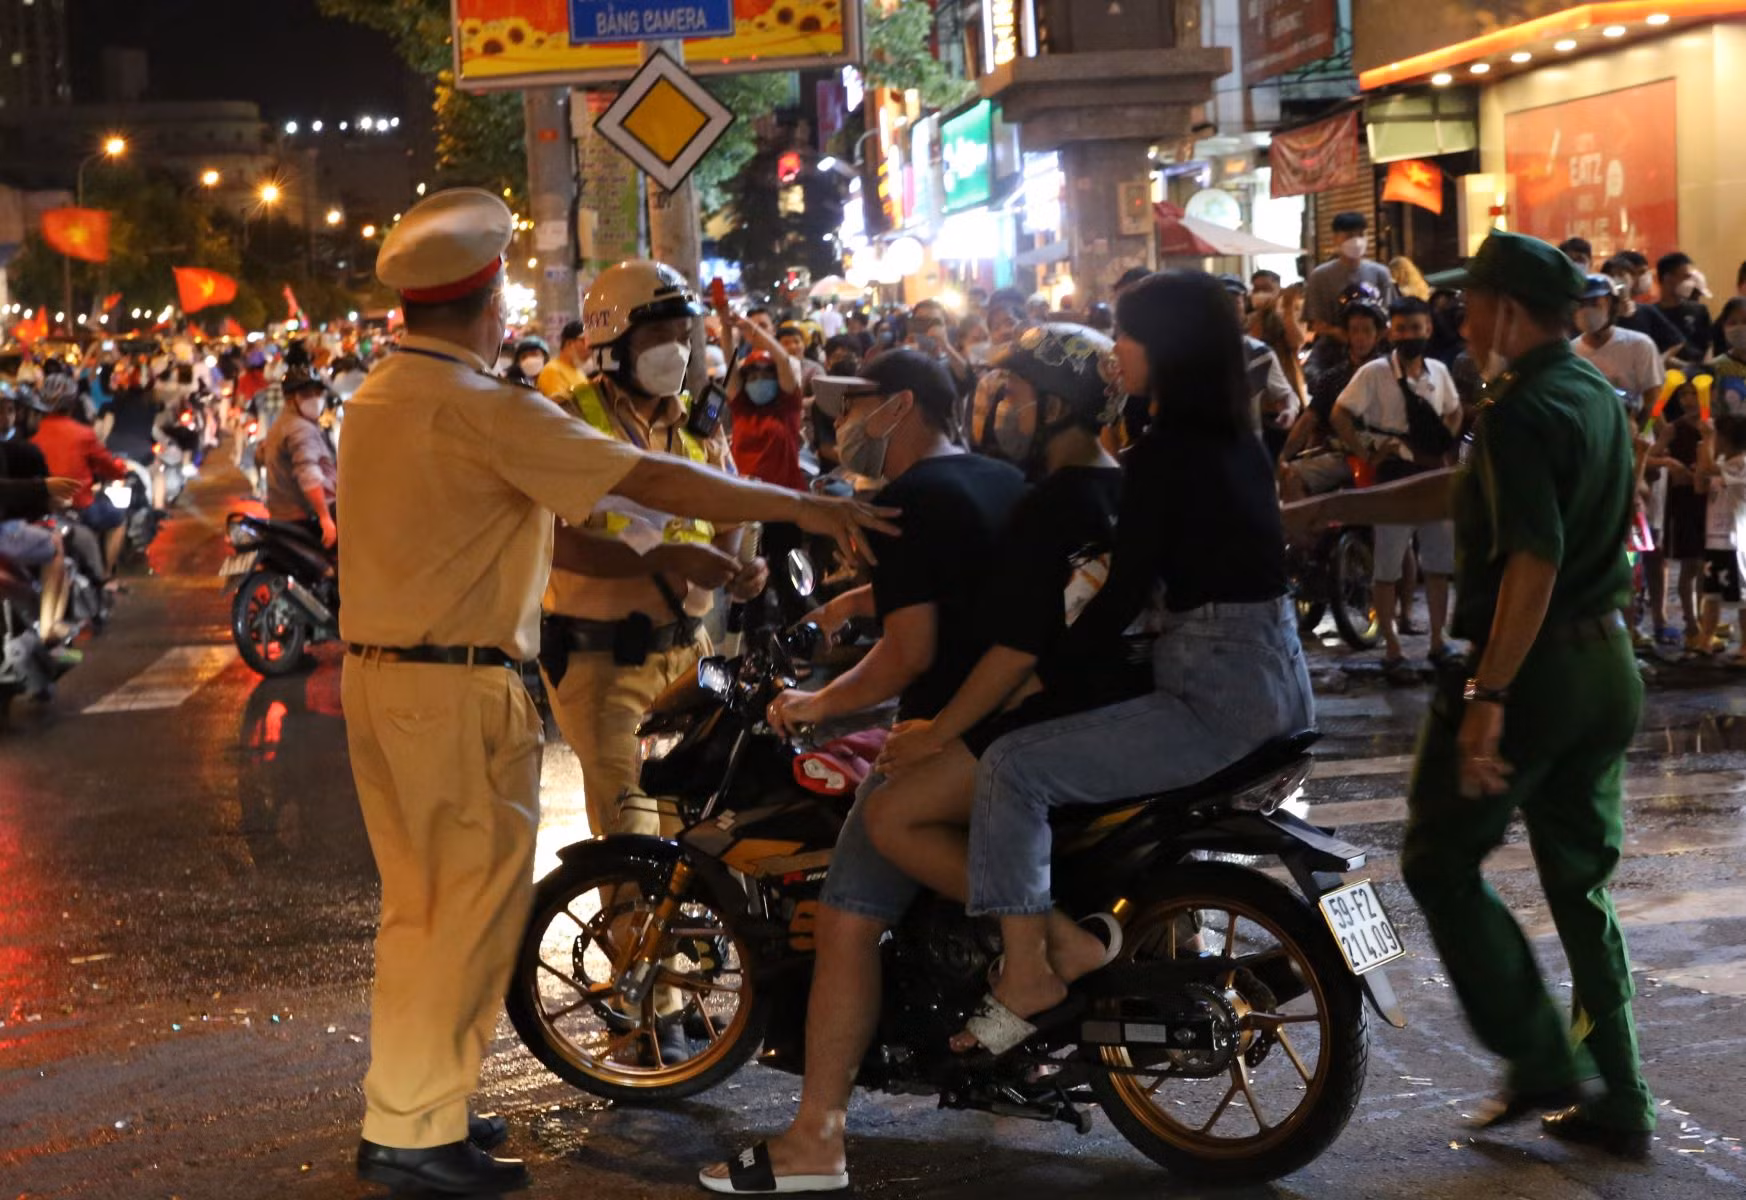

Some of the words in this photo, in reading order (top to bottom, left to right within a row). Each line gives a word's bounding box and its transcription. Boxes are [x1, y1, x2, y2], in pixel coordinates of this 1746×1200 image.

[643, 7, 707, 32] CAMERA
[1328, 888, 1377, 929] 59-F2
[1341, 920, 1398, 968] 214.09
